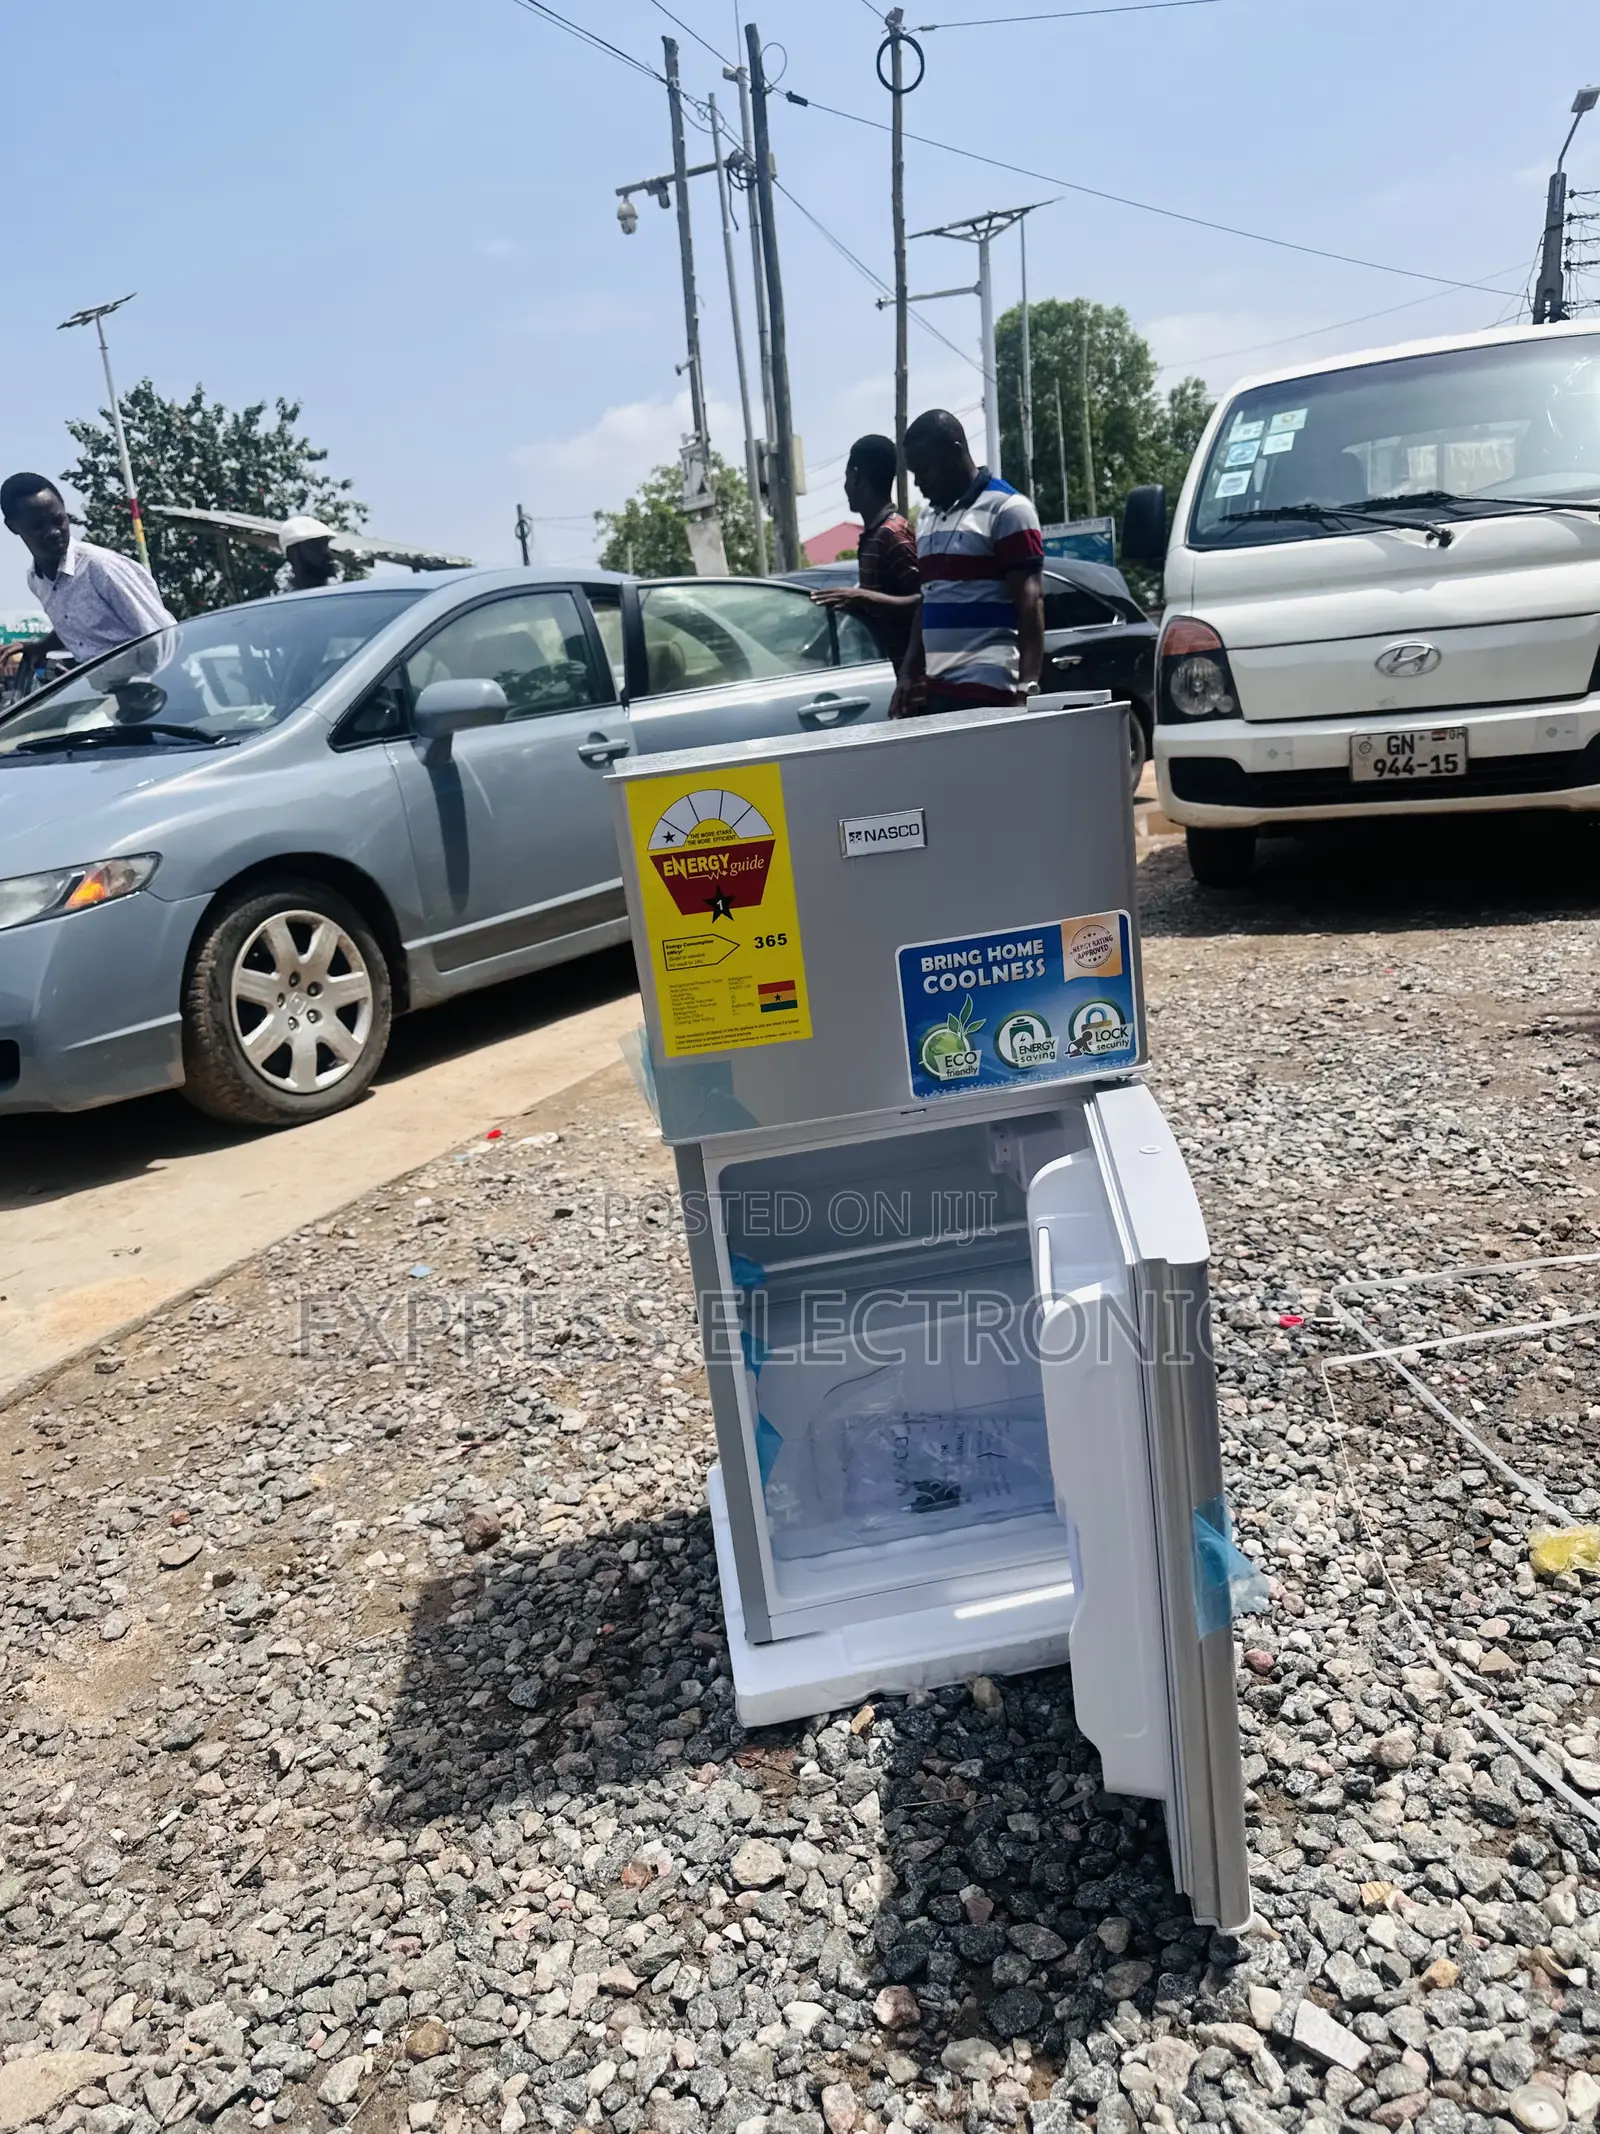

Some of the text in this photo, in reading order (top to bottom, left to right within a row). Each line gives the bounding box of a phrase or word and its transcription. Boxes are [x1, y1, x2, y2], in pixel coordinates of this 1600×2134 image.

[1387, 734, 1415, 755] GN
[1373, 753, 1458, 778] 944-15
[713, 835, 736, 843] EFFICIENT
[864, 823, 920, 843] NASCO
[662, 853, 765, 880] ENERGY guide
[716, 899, 723, 911] 1
[754, 933, 787, 949] 365
[921, 939, 1044, 972] BRING HOME
[1077, 943, 1109, 960] APPROVED
[923, 957, 1046, 994] COOLNESS
[1095, 1026, 1129, 1042] LOCK
[1019, 1040, 1056, 1055] ENERGY
[1096, 1039, 1130, 1051] security
[945, 1051, 977, 1068] ECO
[1020, 1051, 1056, 1063] saving
[946, 1066, 978, 1078] friendly
